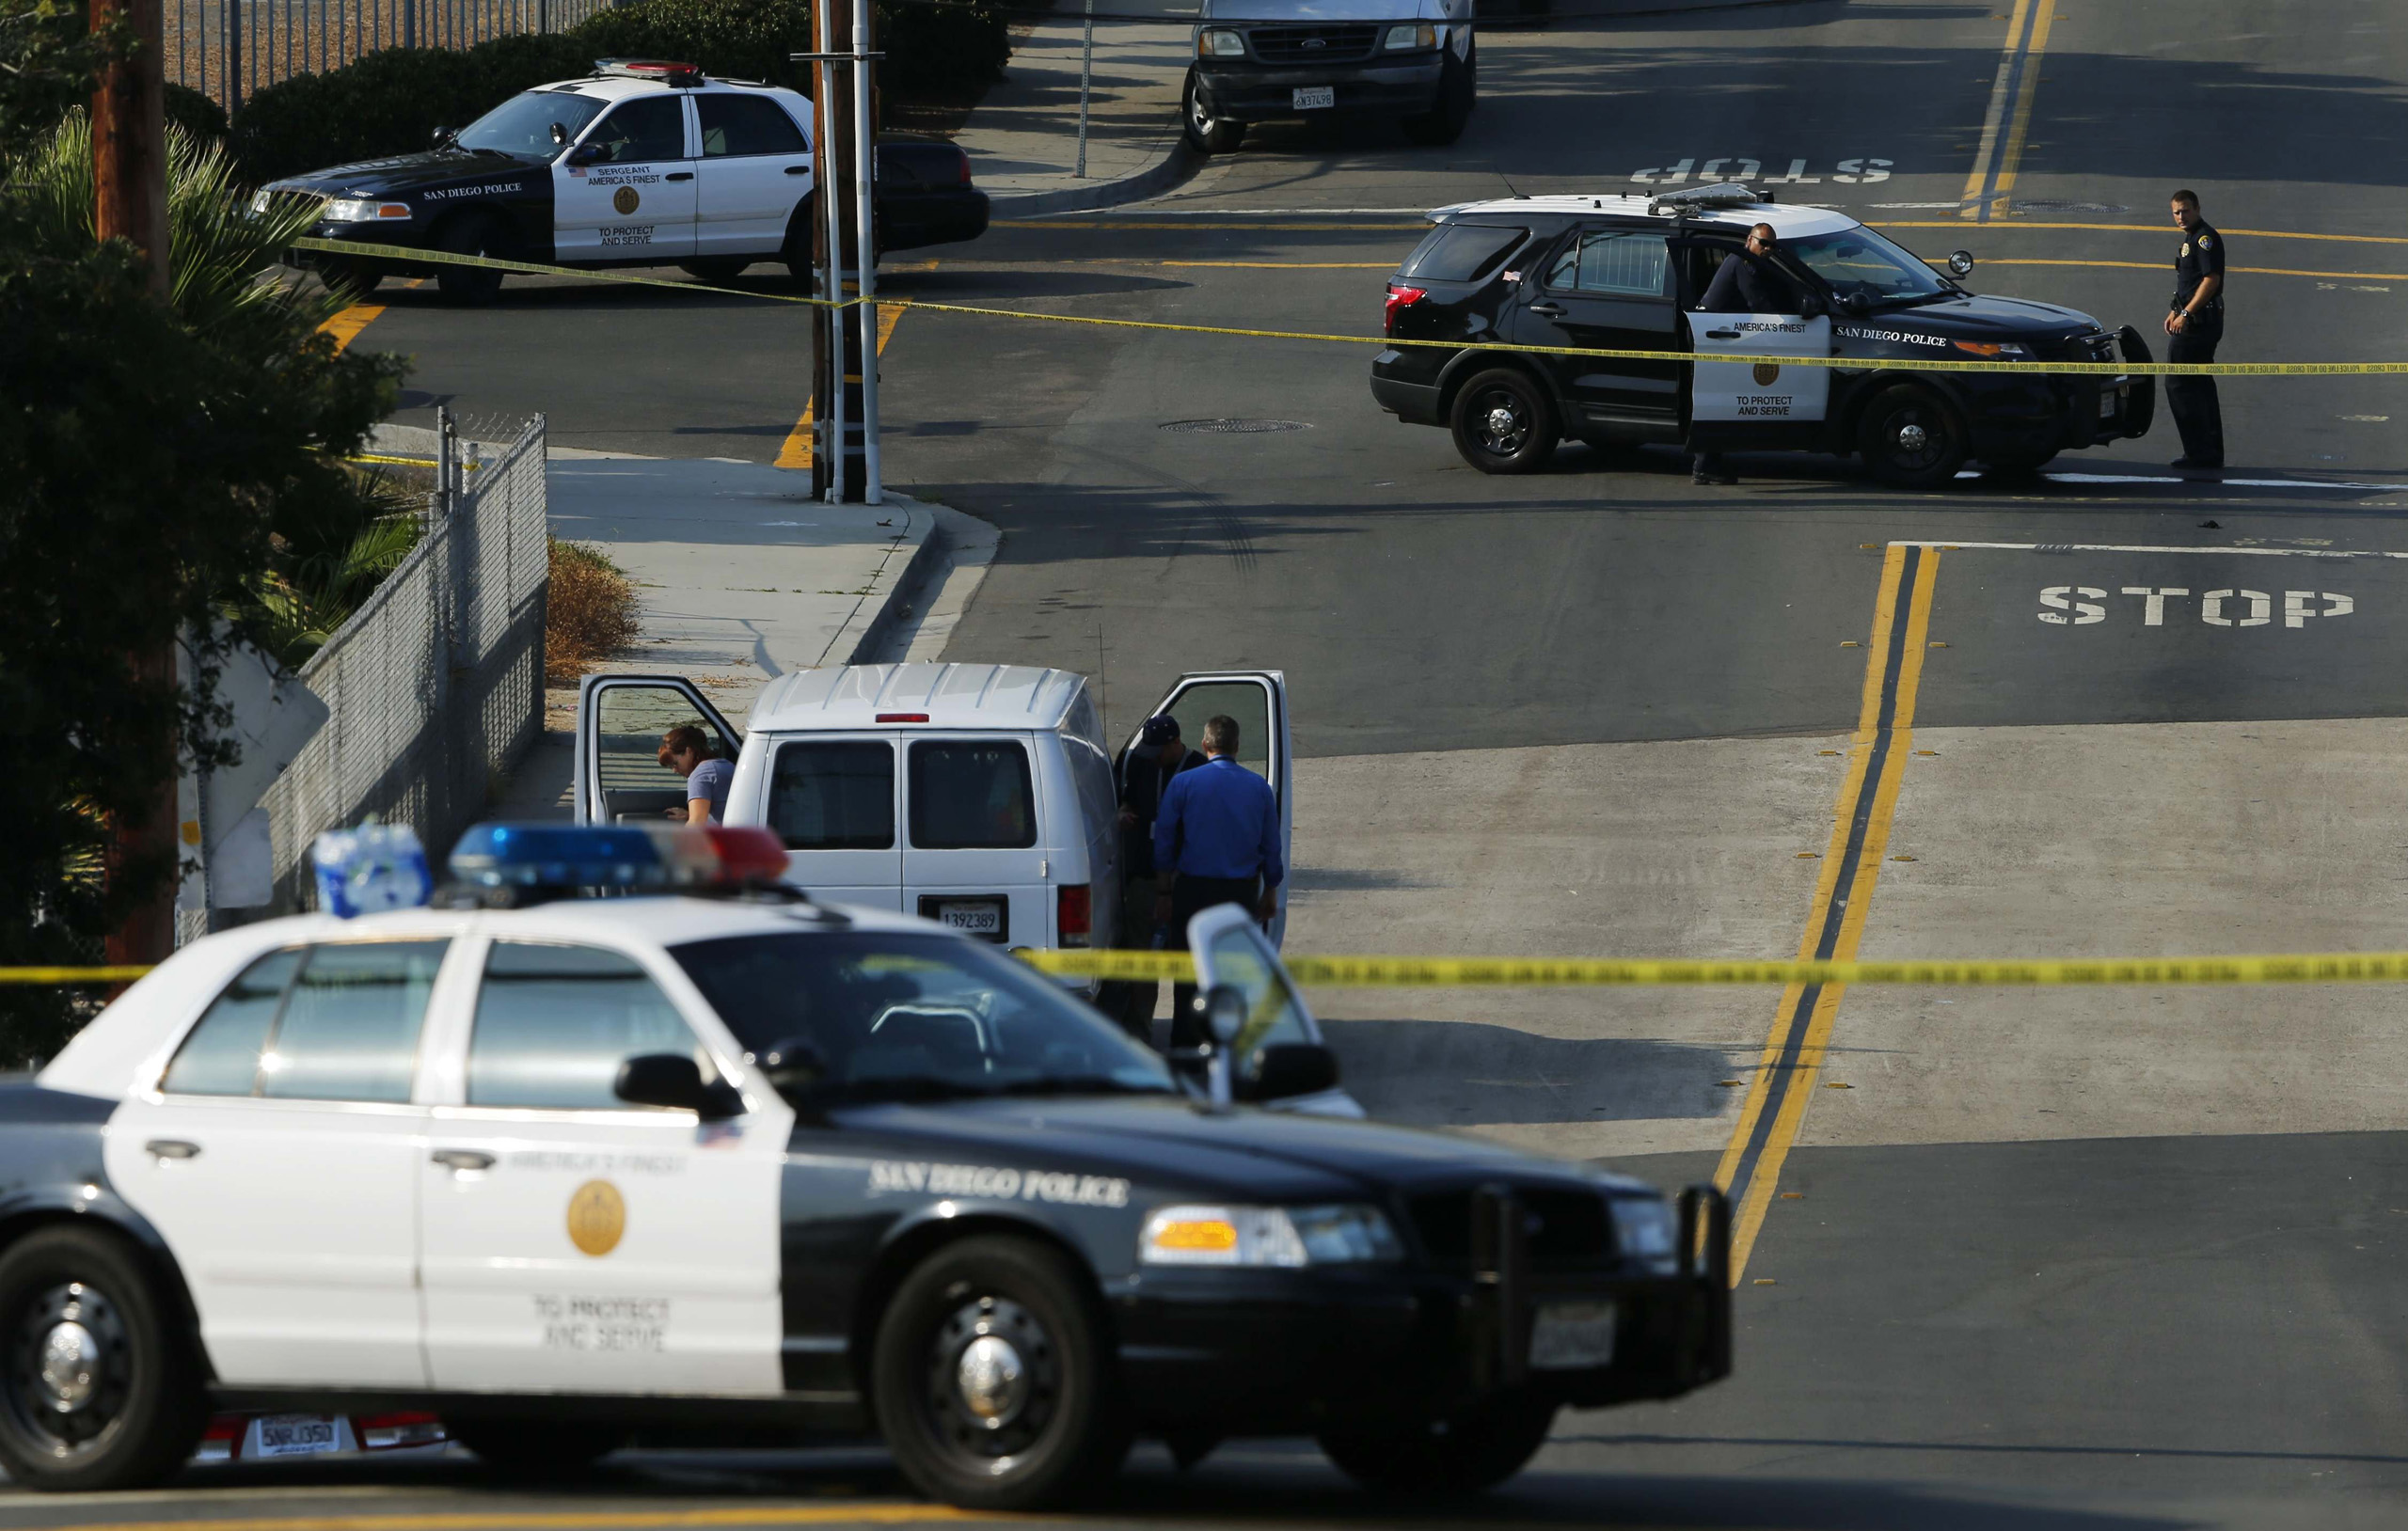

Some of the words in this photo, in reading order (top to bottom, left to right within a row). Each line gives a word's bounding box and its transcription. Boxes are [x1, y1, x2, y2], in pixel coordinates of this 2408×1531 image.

[1296, 94, 1332, 106] 6N37498
[597, 166, 650, 176] SERGEANT
[1629, 158, 1893, 184] STOP
[633, 175, 660, 184] FINEST
[423, 190, 446, 200] SAN
[448, 186, 482, 197] DIEGO
[484, 182, 522, 195] POLICE
[599, 228, 610, 237] TO
[612, 226, 655, 236] PROTECT
[601, 236, 620, 246] AND
[621, 235, 652, 245] SERVE
[1734, 322, 1778, 333] AMERICA'S
[1779, 324, 1806, 333] FINEST
[1836, 326, 1860, 338] SAN
[1861, 328, 1900, 342] DIEGO
[1903, 332, 1947, 347] POLICE
[1736, 396, 1749, 405] TO
[1751, 396, 1793, 405] PROTECT
[1737, 406, 1758, 416] AND
[1759, 406, 1790, 416] SERVE
[2037, 586, 2353, 628] STOP
[944, 912, 995, 928] 1392389
[869, 1159, 928, 1192] SAN
[928, 1162, 1021, 1199] DIEGO
[1022, 1170, 1131, 1207] POLICE
[533, 1295, 562, 1318] TO
[570, 1296, 671, 1319] PROTECT
